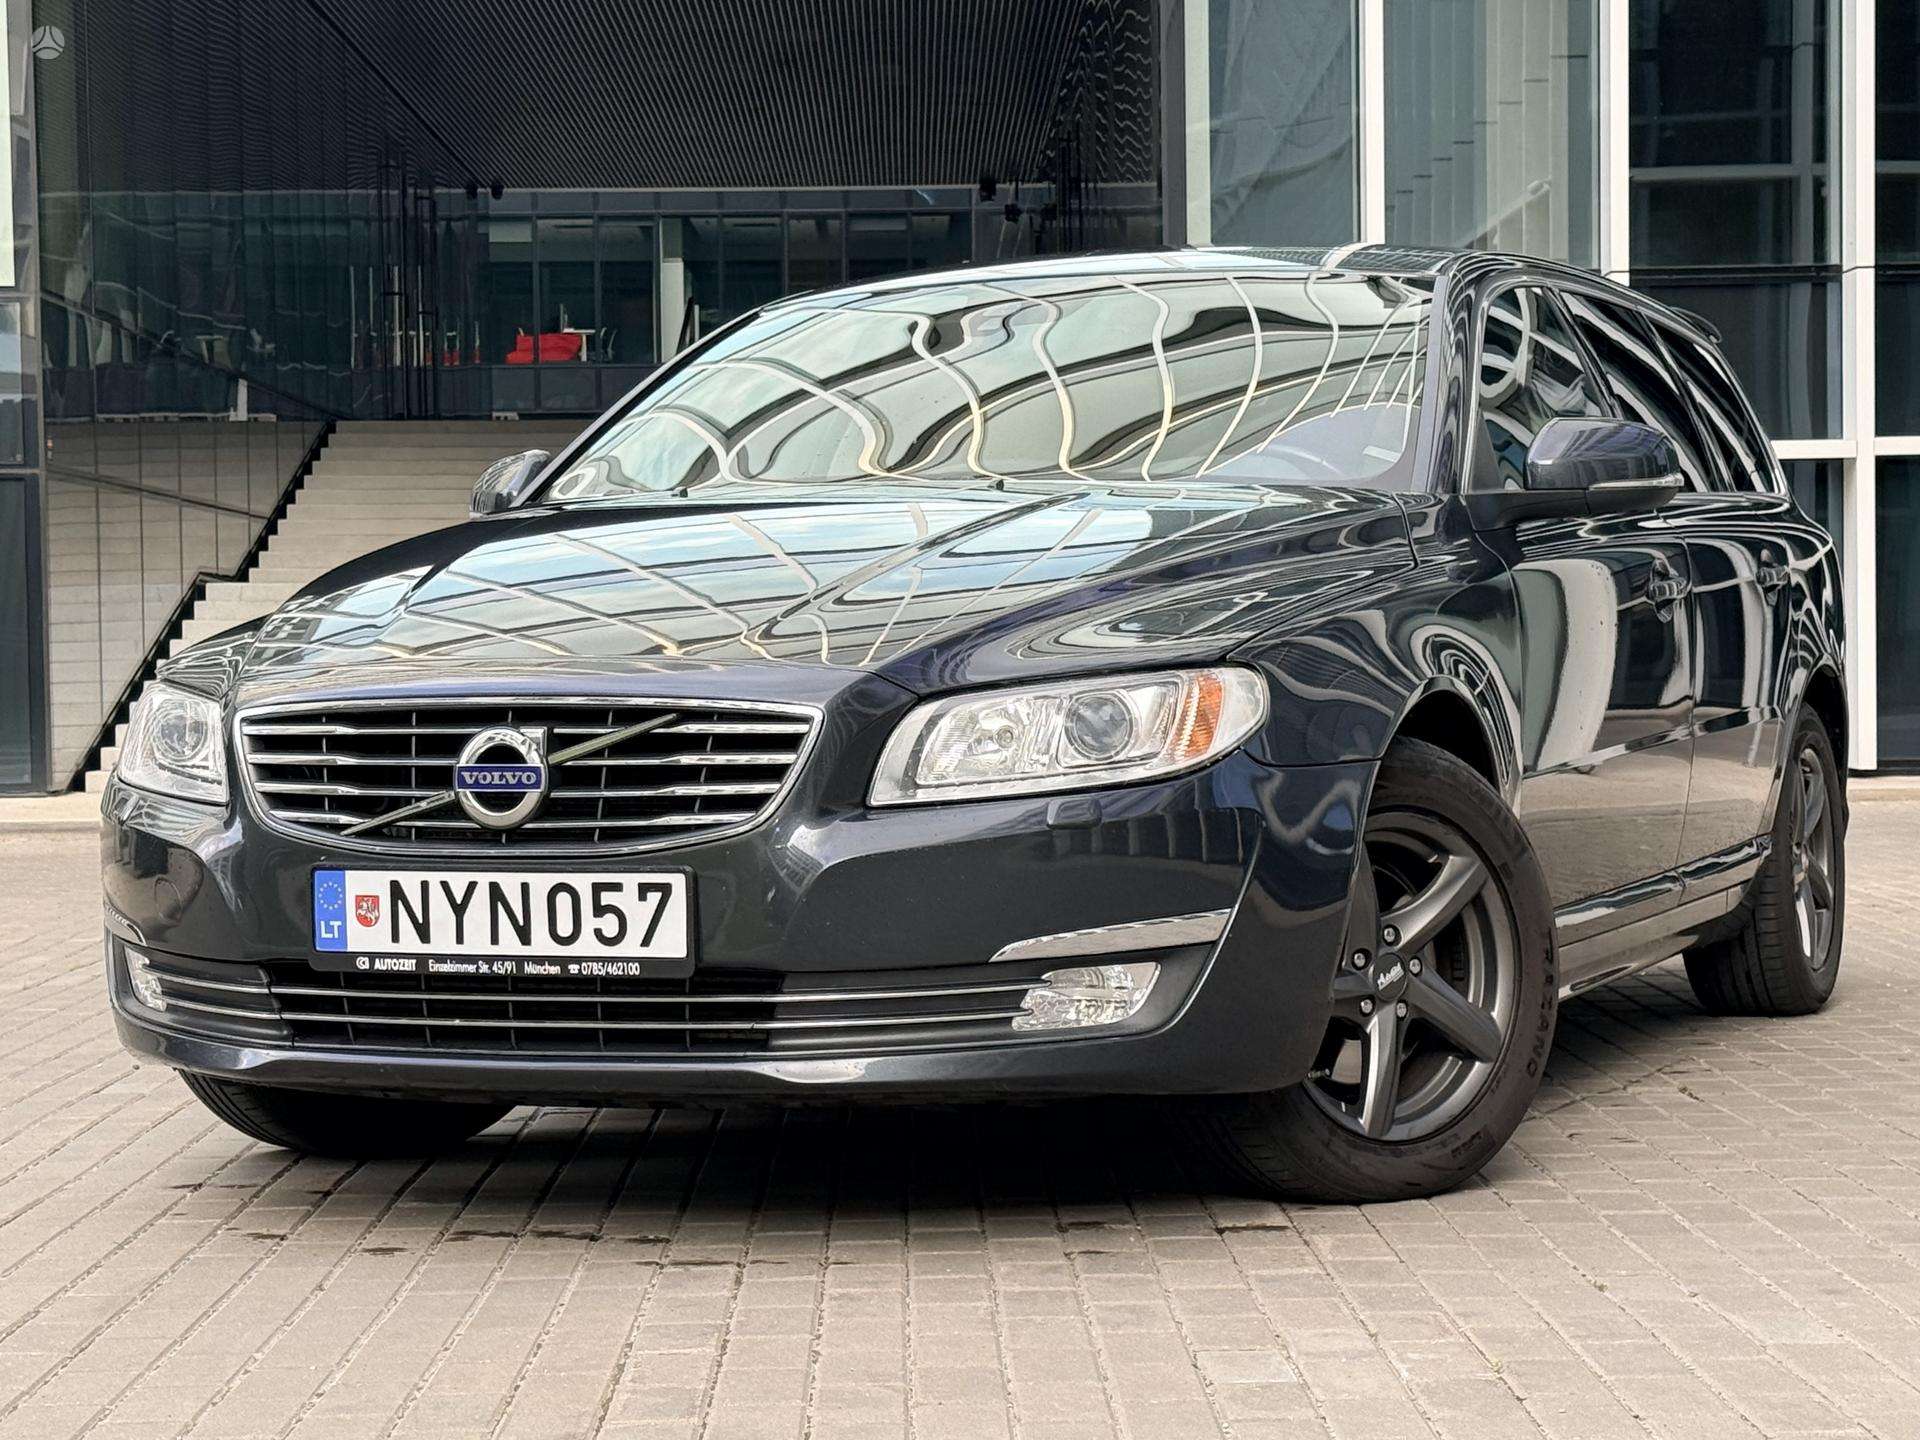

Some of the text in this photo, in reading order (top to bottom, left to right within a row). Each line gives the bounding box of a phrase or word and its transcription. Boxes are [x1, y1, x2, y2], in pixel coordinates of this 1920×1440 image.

[461, 771, 537, 785] VOLVO
[389, 880, 673, 948] NYN057
[319, 920, 342, 939] LT
[374, 957, 417, 971] AUTOZEIT
[478, 960, 491, 974] Str.
[492, 960, 516, 974] 45/91
[524, 960, 561, 974] München
[581, 961, 641, 976] 0785/462100
